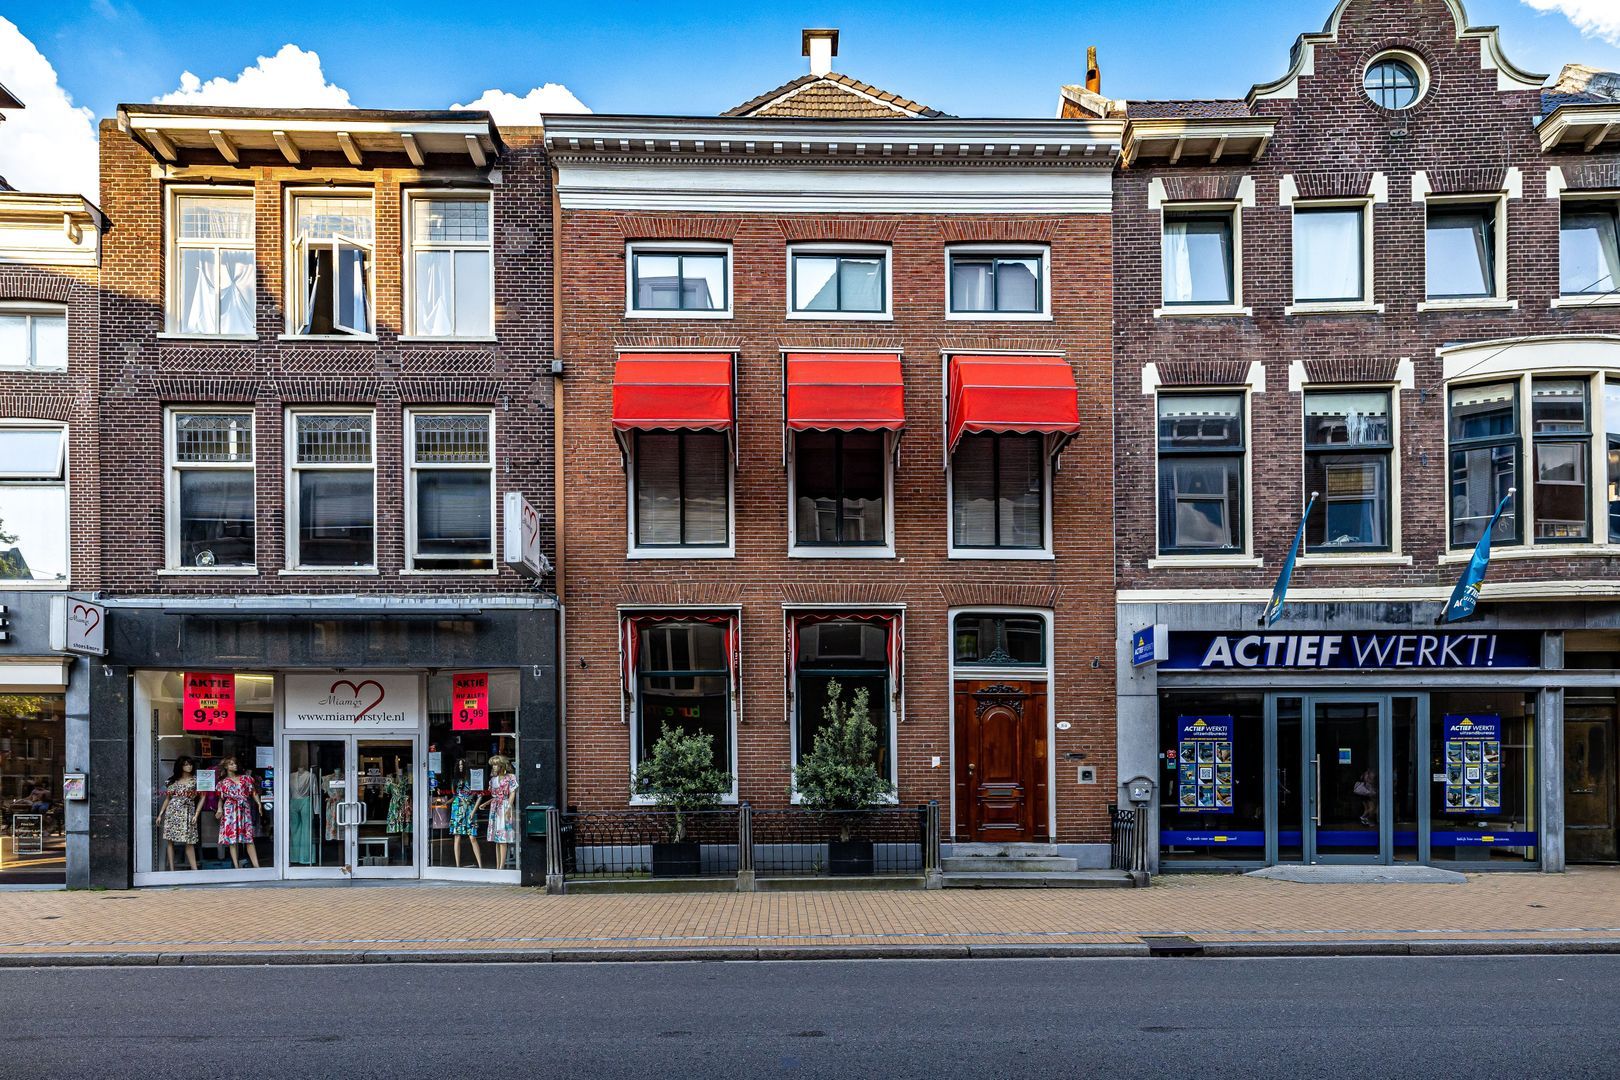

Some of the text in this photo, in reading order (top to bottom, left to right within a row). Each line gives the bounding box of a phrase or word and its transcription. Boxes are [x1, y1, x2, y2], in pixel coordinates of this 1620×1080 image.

[1201, 635, 1497, 666] ACTIEF WERKT!
[189, 679, 230, 688] AKTIE
[456, 679, 484, 688] AKTIE
[193, 709, 228, 726] 9,99
[460, 709, 484, 725] 9,99
